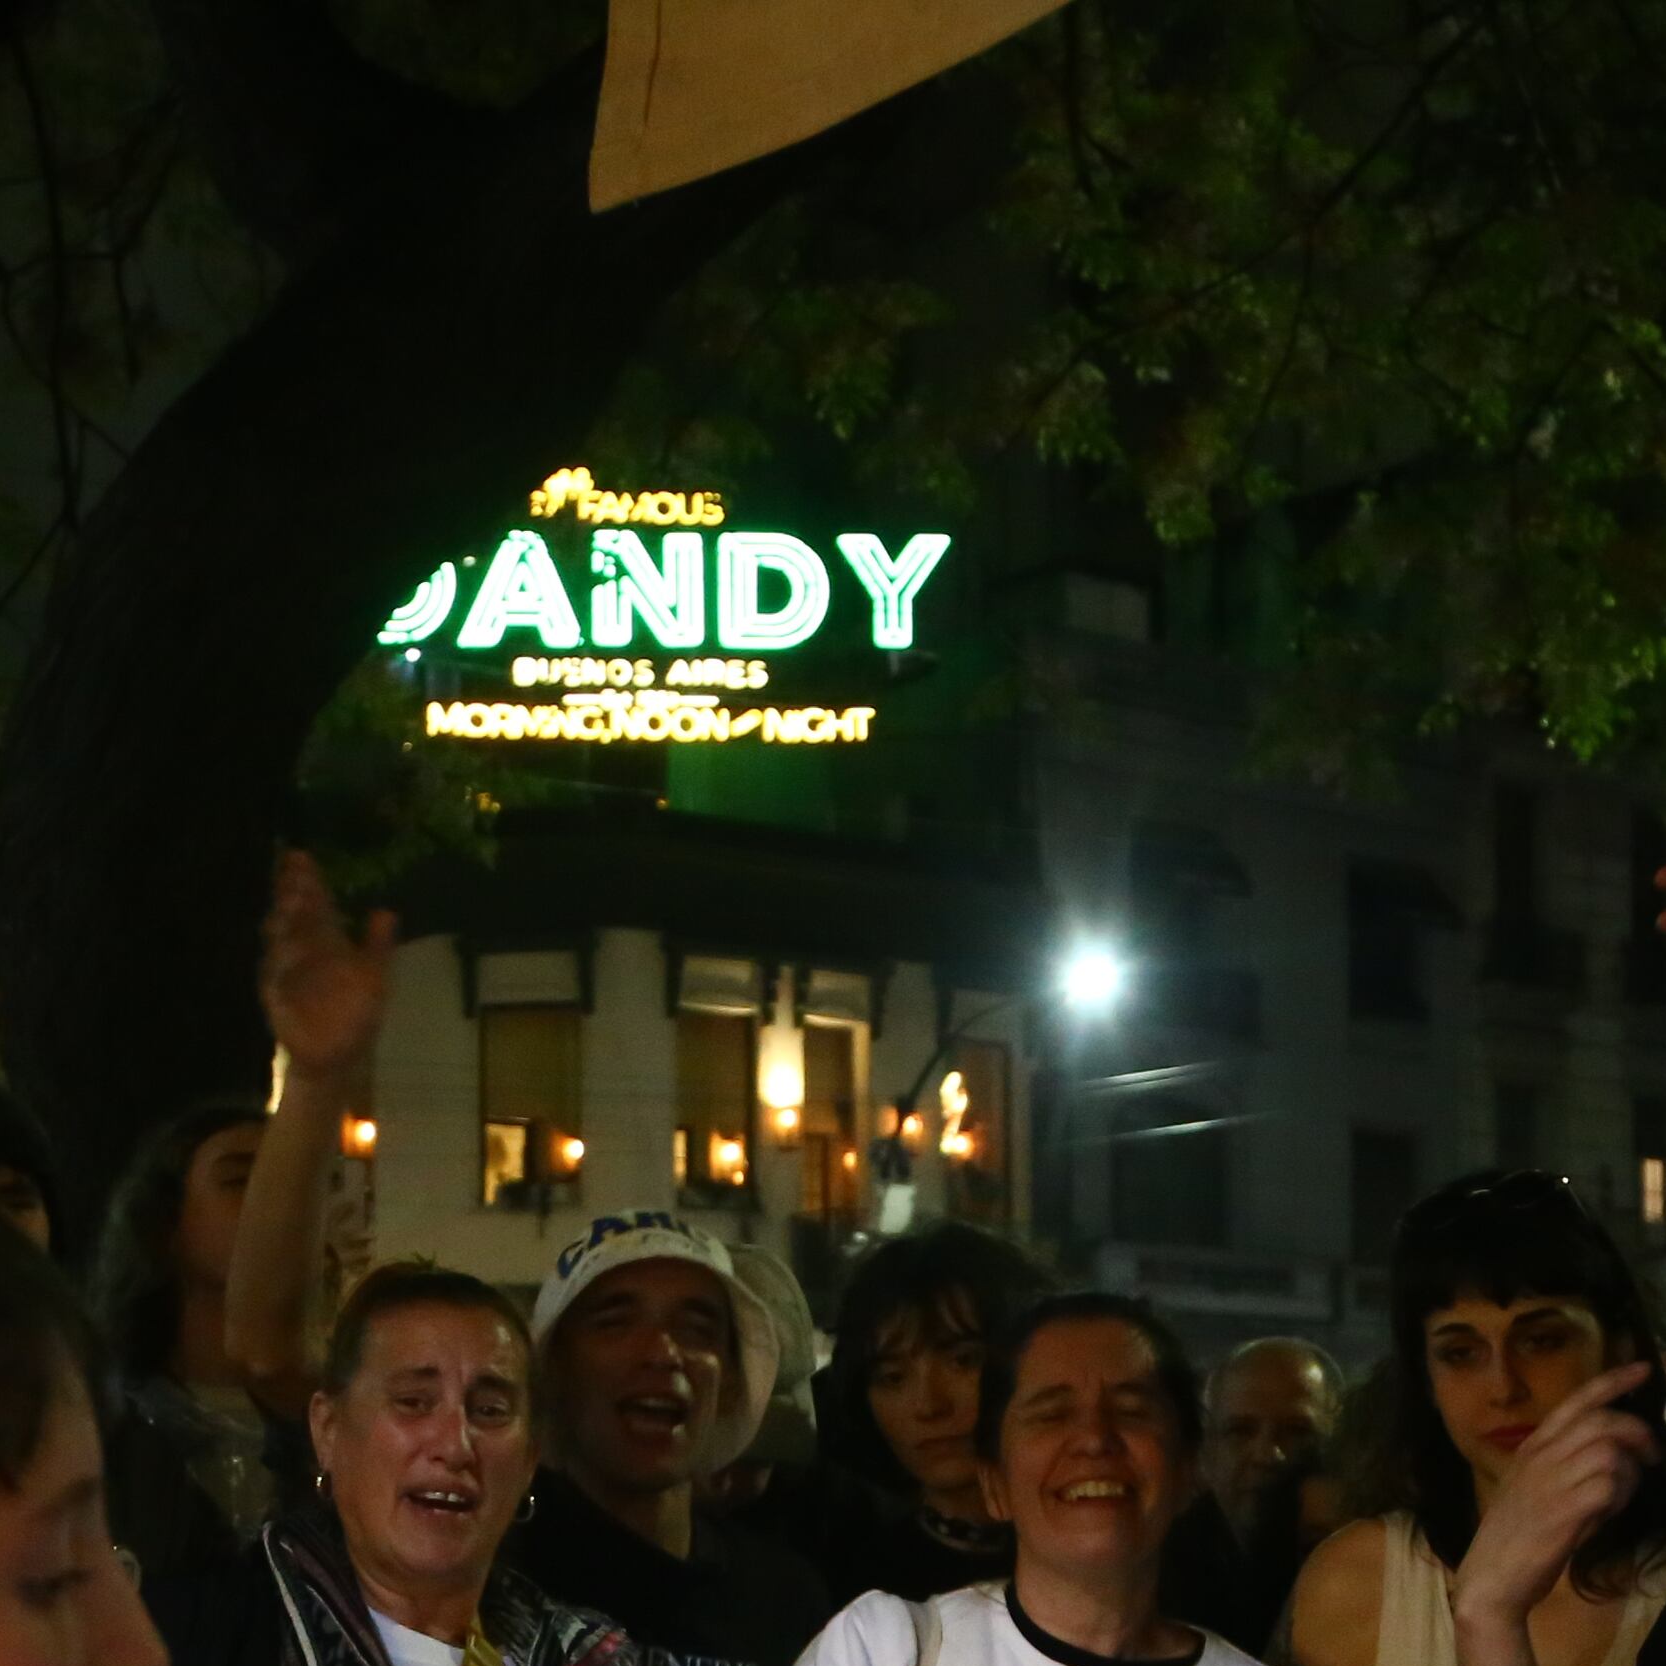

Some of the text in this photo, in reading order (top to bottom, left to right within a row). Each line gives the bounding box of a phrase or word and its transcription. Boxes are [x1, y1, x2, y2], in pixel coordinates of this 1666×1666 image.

[577, 489, 726, 527] FAMOUS
[511, 656, 770, 690] BUENOS AIRES
[761, 706, 878, 743] NIGHT
